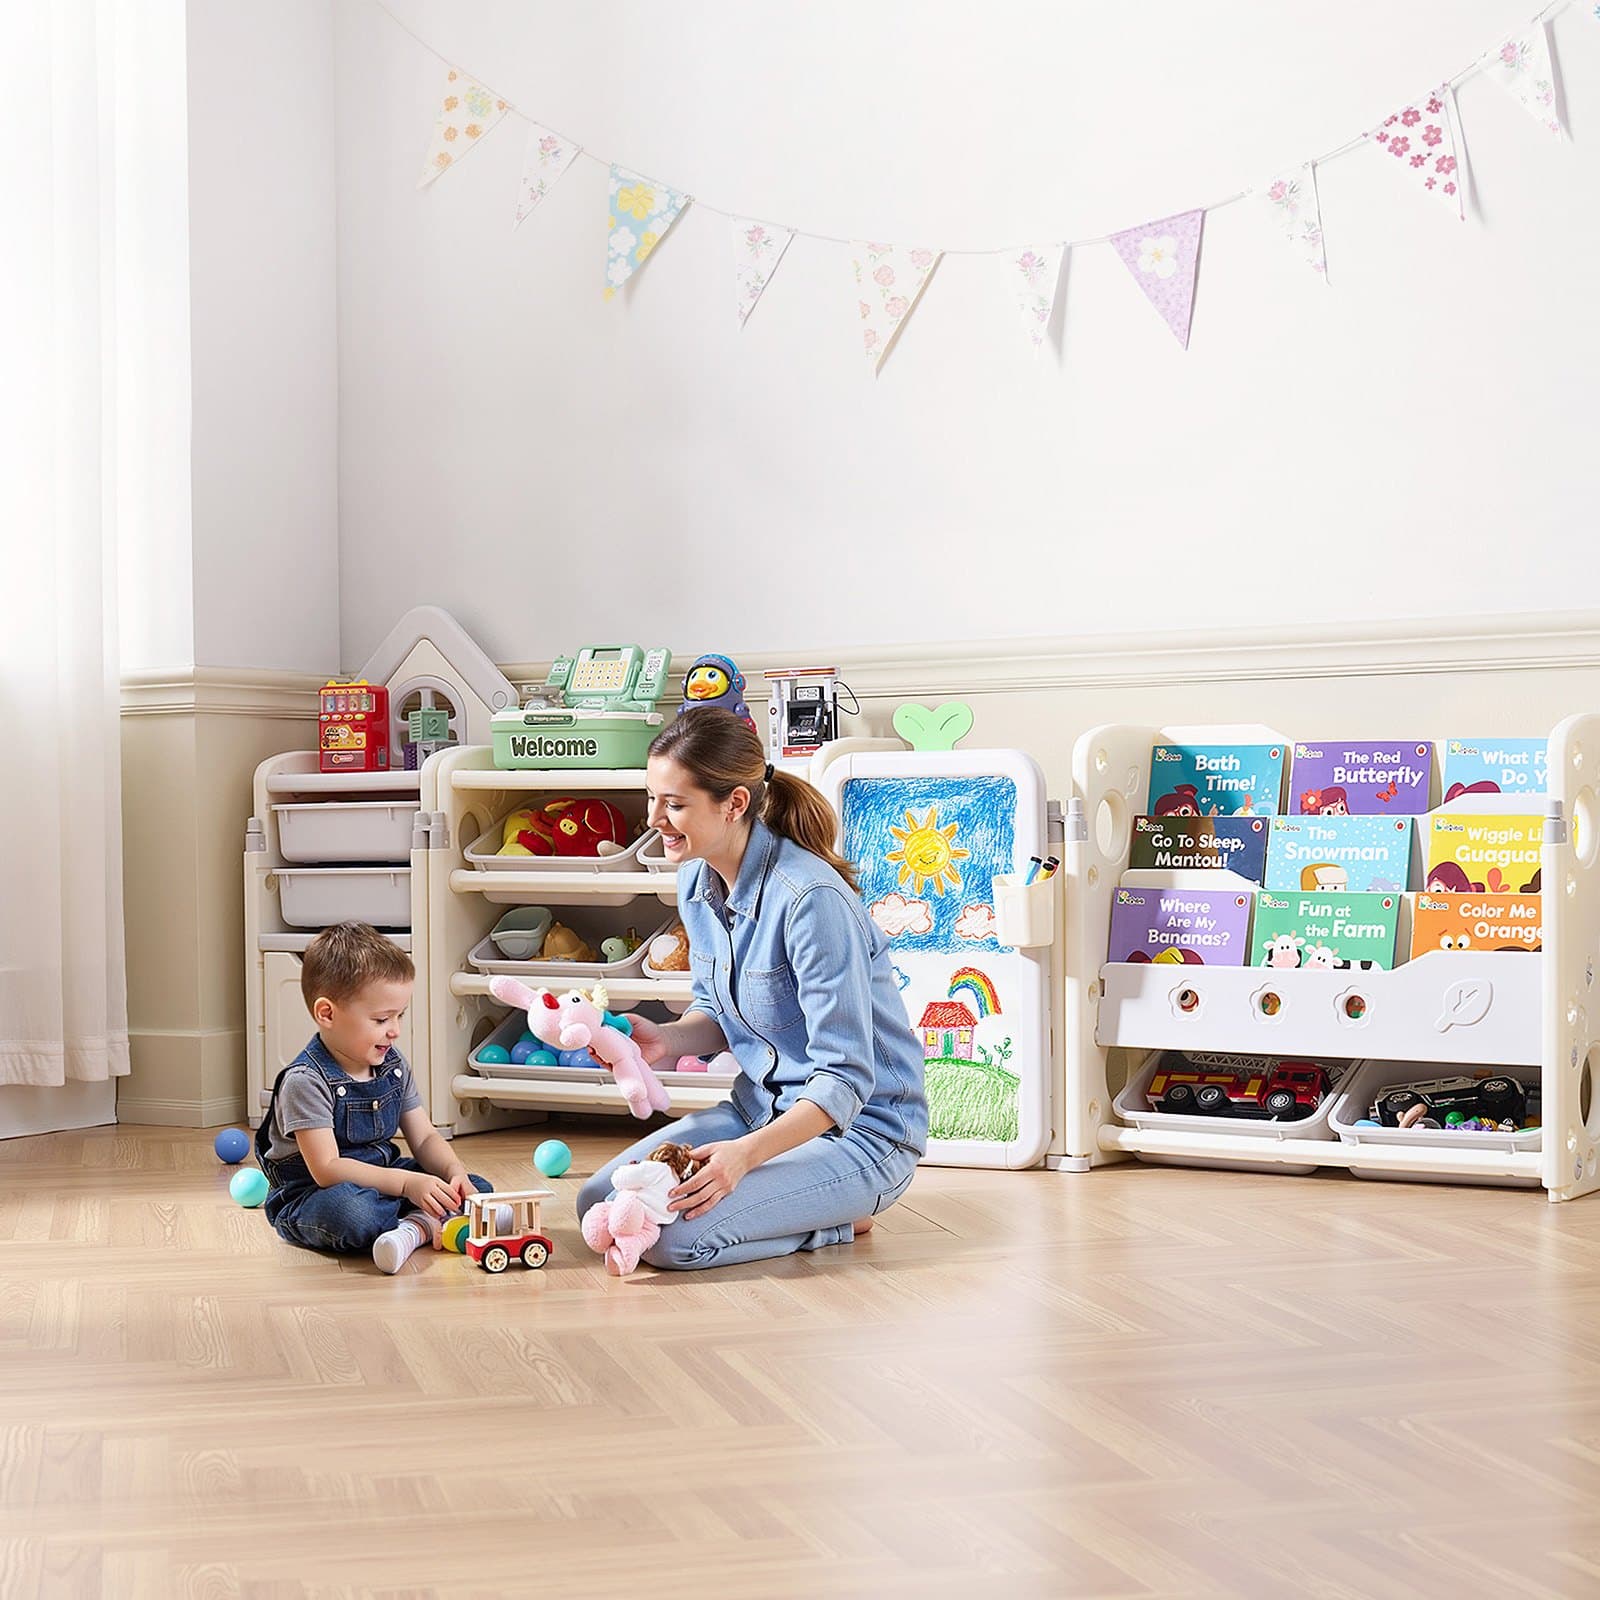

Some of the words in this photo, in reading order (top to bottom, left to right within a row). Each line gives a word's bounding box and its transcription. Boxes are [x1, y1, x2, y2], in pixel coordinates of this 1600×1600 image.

[510, 735, 598, 758] Welcome
[1195, 754, 1240, 771] Bath
[1343, 751, 1369, 763] The
[1373, 751, 1401, 763] Red
[1482, 750, 1528, 764] What
[1206, 775, 1256, 791] Time!
[1333, 766, 1424, 788] Butterfly
[1501, 769, 1527, 785] Do
[1533, 769, 1549, 785] Y
[1308, 826, 1337, 841] The
[1467, 827, 1523, 844] Wiggle
[1528, 827, 1543, 842] Li
[1152, 834, 1172, 848] Go
[1177, 834, 1194, 848] To
[1199, 833, 1245, 852] Sleep,
[1284, 842, 1389, 861] Snowman
[1155, 852, 1229, 868] Mantou!
[1160, 898, 1211, 913] Where
[1298, 901, 1332, 917] Fun
[1335, 904, 1352, 917] at
[1458, 903, 1504, 918] Color
[1508, 903, 1537, 918] Me
[1167, 916, 1191, 928] Are
[1195, 916, 1216, 931] My
[1305, 924, 1329, 937] the
[1332, 919, 1386, 938] Farm
[1148, 929, 1231, 946] Bananas?
